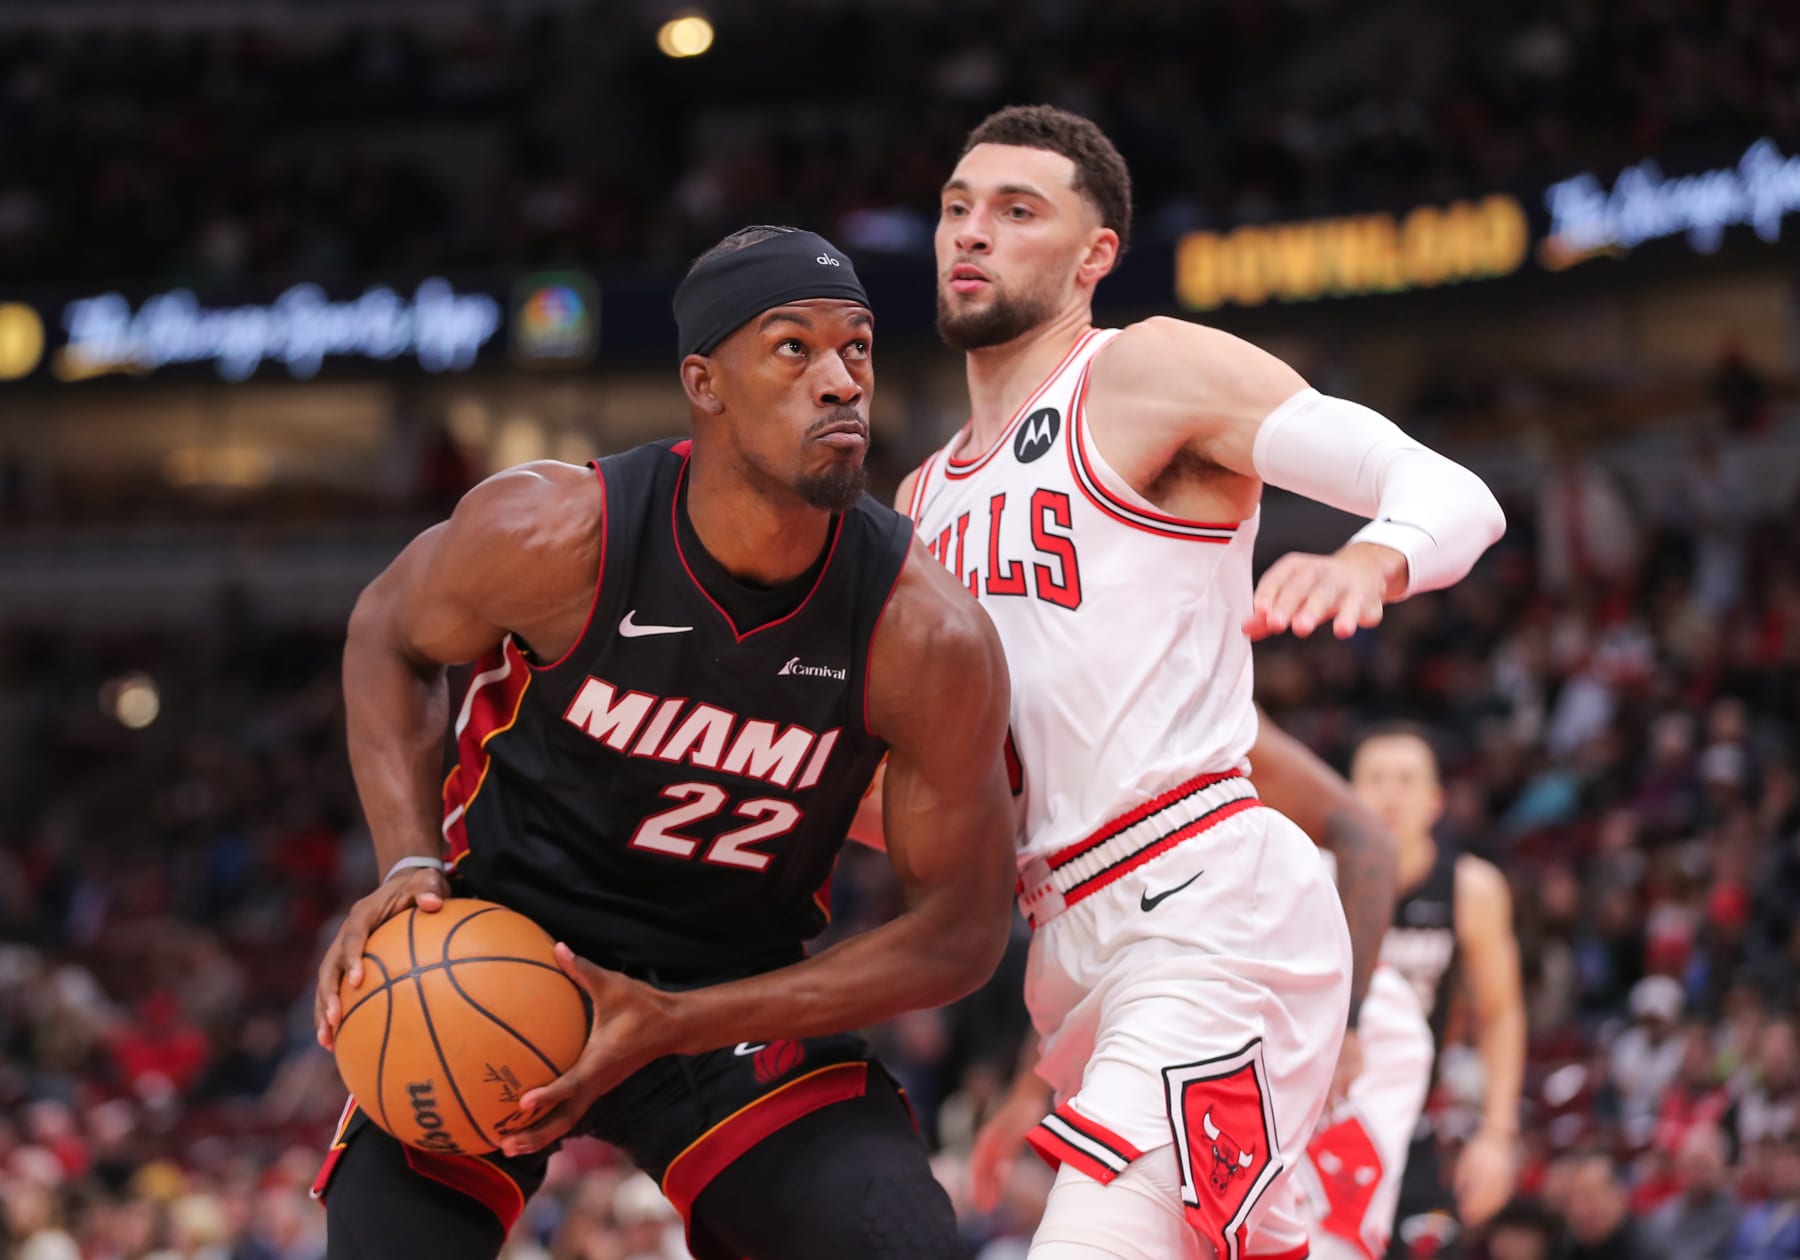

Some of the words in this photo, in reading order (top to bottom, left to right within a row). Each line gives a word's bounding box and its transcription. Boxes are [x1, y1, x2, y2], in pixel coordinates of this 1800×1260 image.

[816, 252, 840, 267] alo
[792, 664, 846, 680] Carnival
[562, 674, 844, 793] MIAMI
[627, 780, 805, 883] 22
